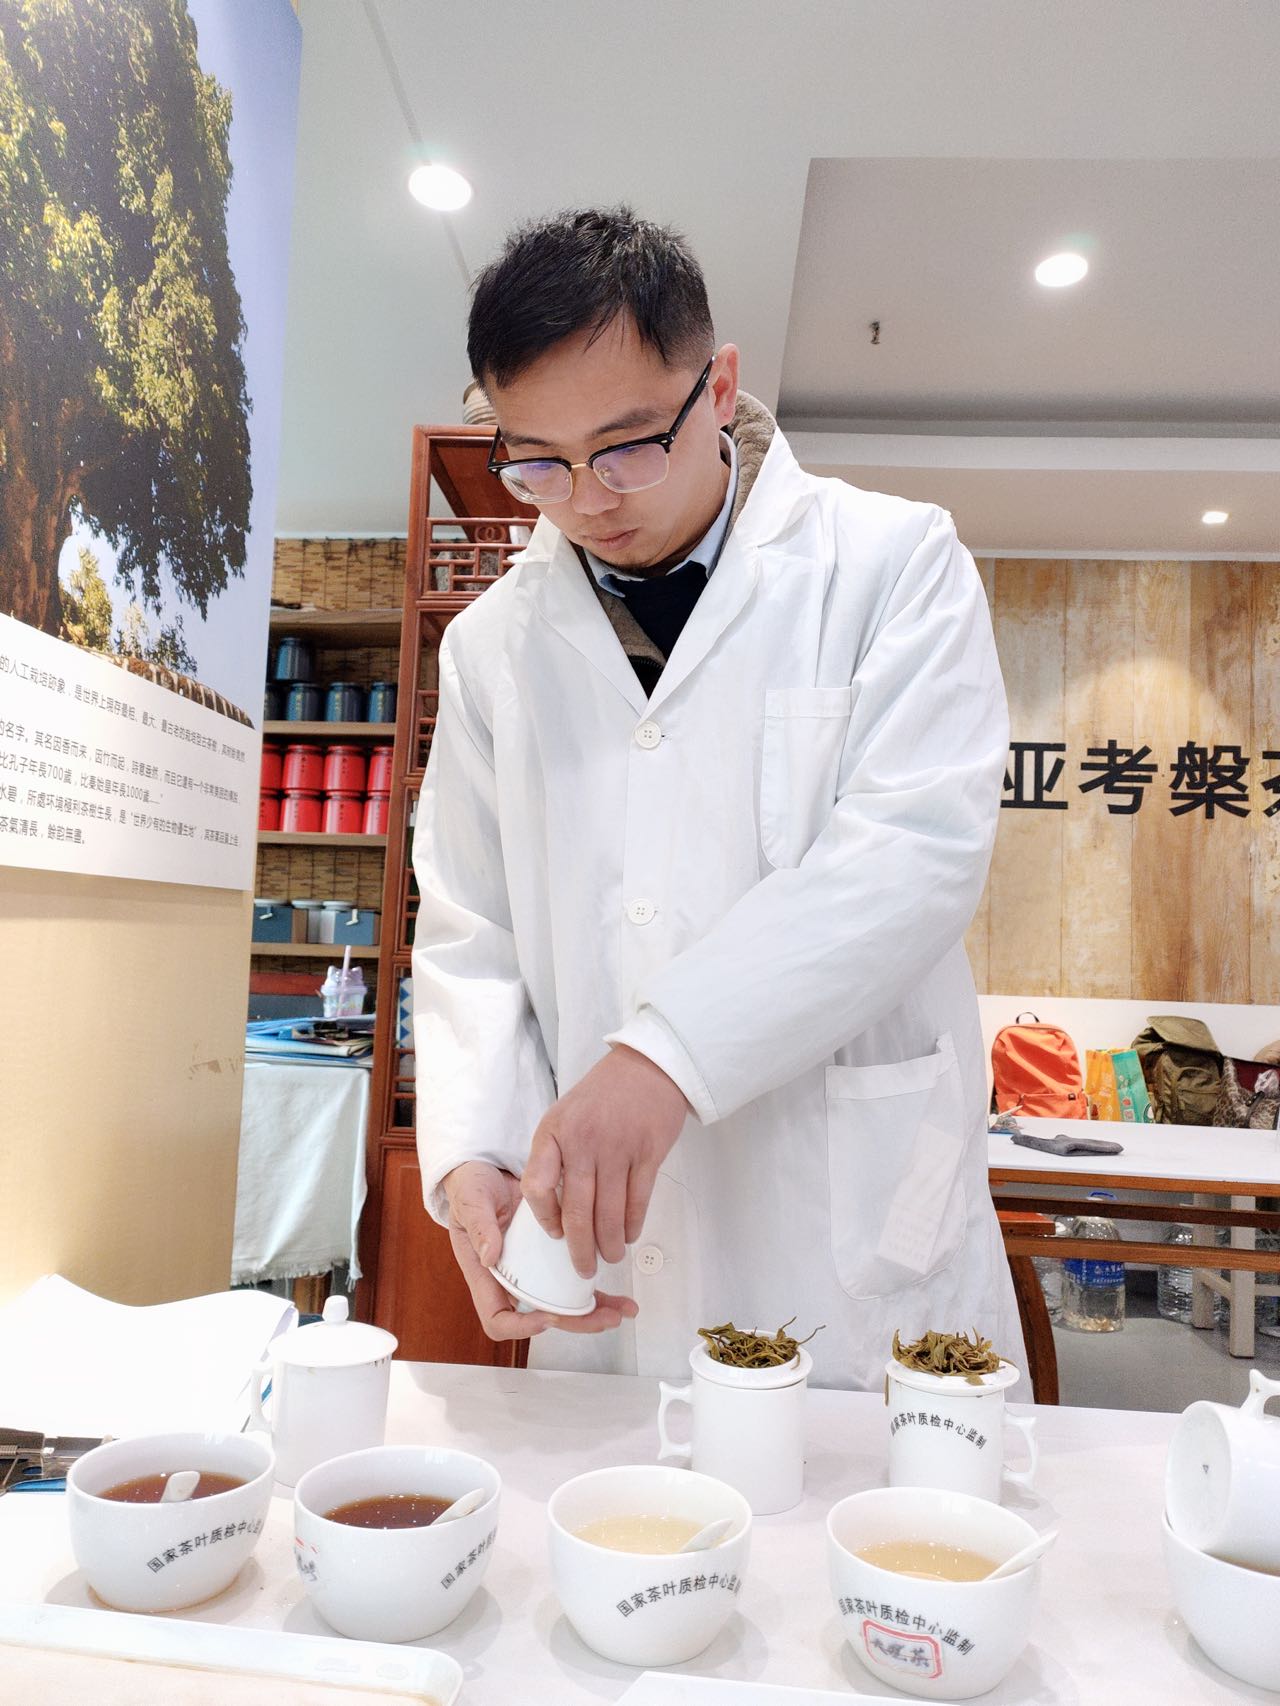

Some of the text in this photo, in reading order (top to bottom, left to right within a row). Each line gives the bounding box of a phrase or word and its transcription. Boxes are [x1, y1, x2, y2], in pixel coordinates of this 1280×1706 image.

[838, 1597, 976, 1656] 国家茶叶质检中心监制
